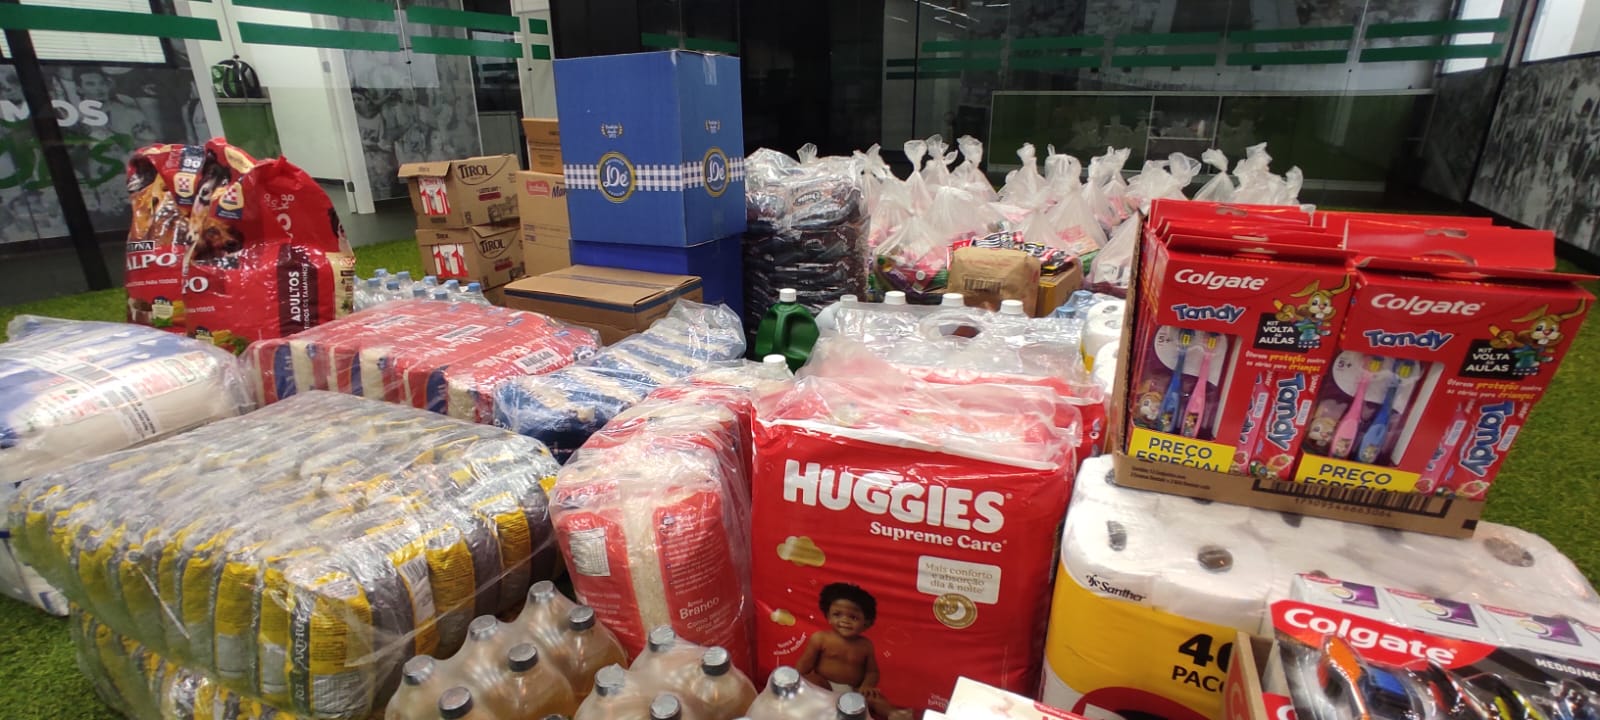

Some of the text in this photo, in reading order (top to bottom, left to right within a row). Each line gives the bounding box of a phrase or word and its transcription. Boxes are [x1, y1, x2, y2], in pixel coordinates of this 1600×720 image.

[458, 164, 491, 179] TIROL
[480, 239, 505, 255] TIROL
[1174, 269, 1265, 291] Colgate
[288, 270, 302, 322] ADULTOS
[1371, 293, 1480, 316] Colgate
[1171, 303, 1246, 323] Tandy
[1258, 337, 1295, 346] AULAS
[1263, 326, 1295, 334] VOLTA
[1363, 328, 1453, 351] Tandy
[1465, 363, 1509, 373] AULAS
[1472, 353, 1511, 361] VOLTA
[1266, 372, 1306, 452] Tandy
[1148, 437, 1213, 460] PREÇO
[1459, 400, 1515, 478] Tandy
[1319, 463, 1393, 486] PREÇO
[783, 459, 1005, 534] HUGGIES
[870, 521, 1003, 553] Supreme Care
[949, 566, 993, 580] conforto
[930, 580, 945, 588] dia
[947, 582, 955, 590] &
[1099, 581, 1145, 602] Santher
[680, 596, 720, 620] Branco
[1284, 608, 1456, 665] Colgate
[1171, 665, 1227, 694] PAC
